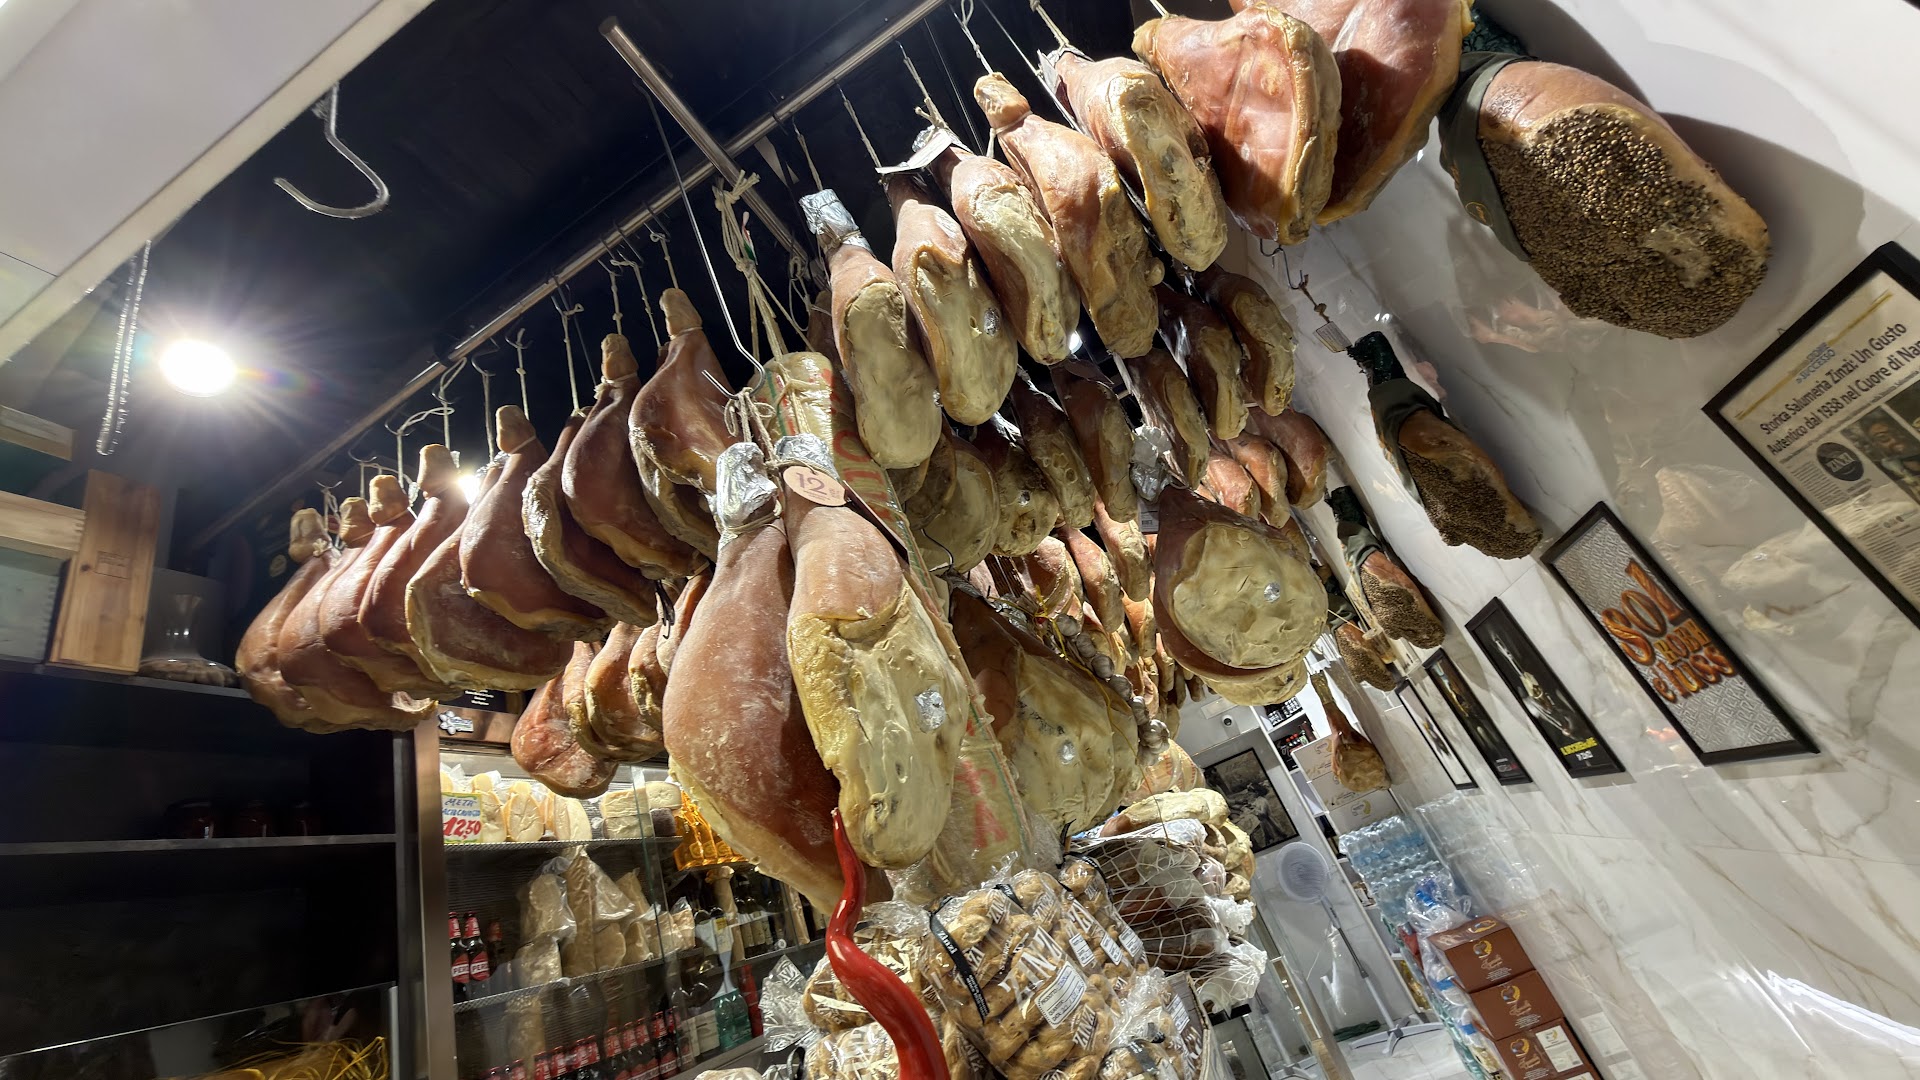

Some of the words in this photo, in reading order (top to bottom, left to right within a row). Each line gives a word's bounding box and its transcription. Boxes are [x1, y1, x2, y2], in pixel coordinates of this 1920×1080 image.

[1760, 410, 1791, 435] Storica
[1785, 379, 1832, 415] Salumeria
[1850, 348, 1874, 364] Un
[1868, 323, 1907, 351] Gusto
[1766, 425, 1808, 456] Autentico
[1805, 411, 1822, 430] dal
[1818, 398, 1845, 420] 1938
[1840, 385, 1861, 404] nel
[1855, 365, 1892, 393] Cuore
[1888, 354, 1905, 371] di
[796, 472, 828, 495] 12
[937, 931, 958, 954] Zinzi
[1072, 1003, 1096, 1049] ZINZI
